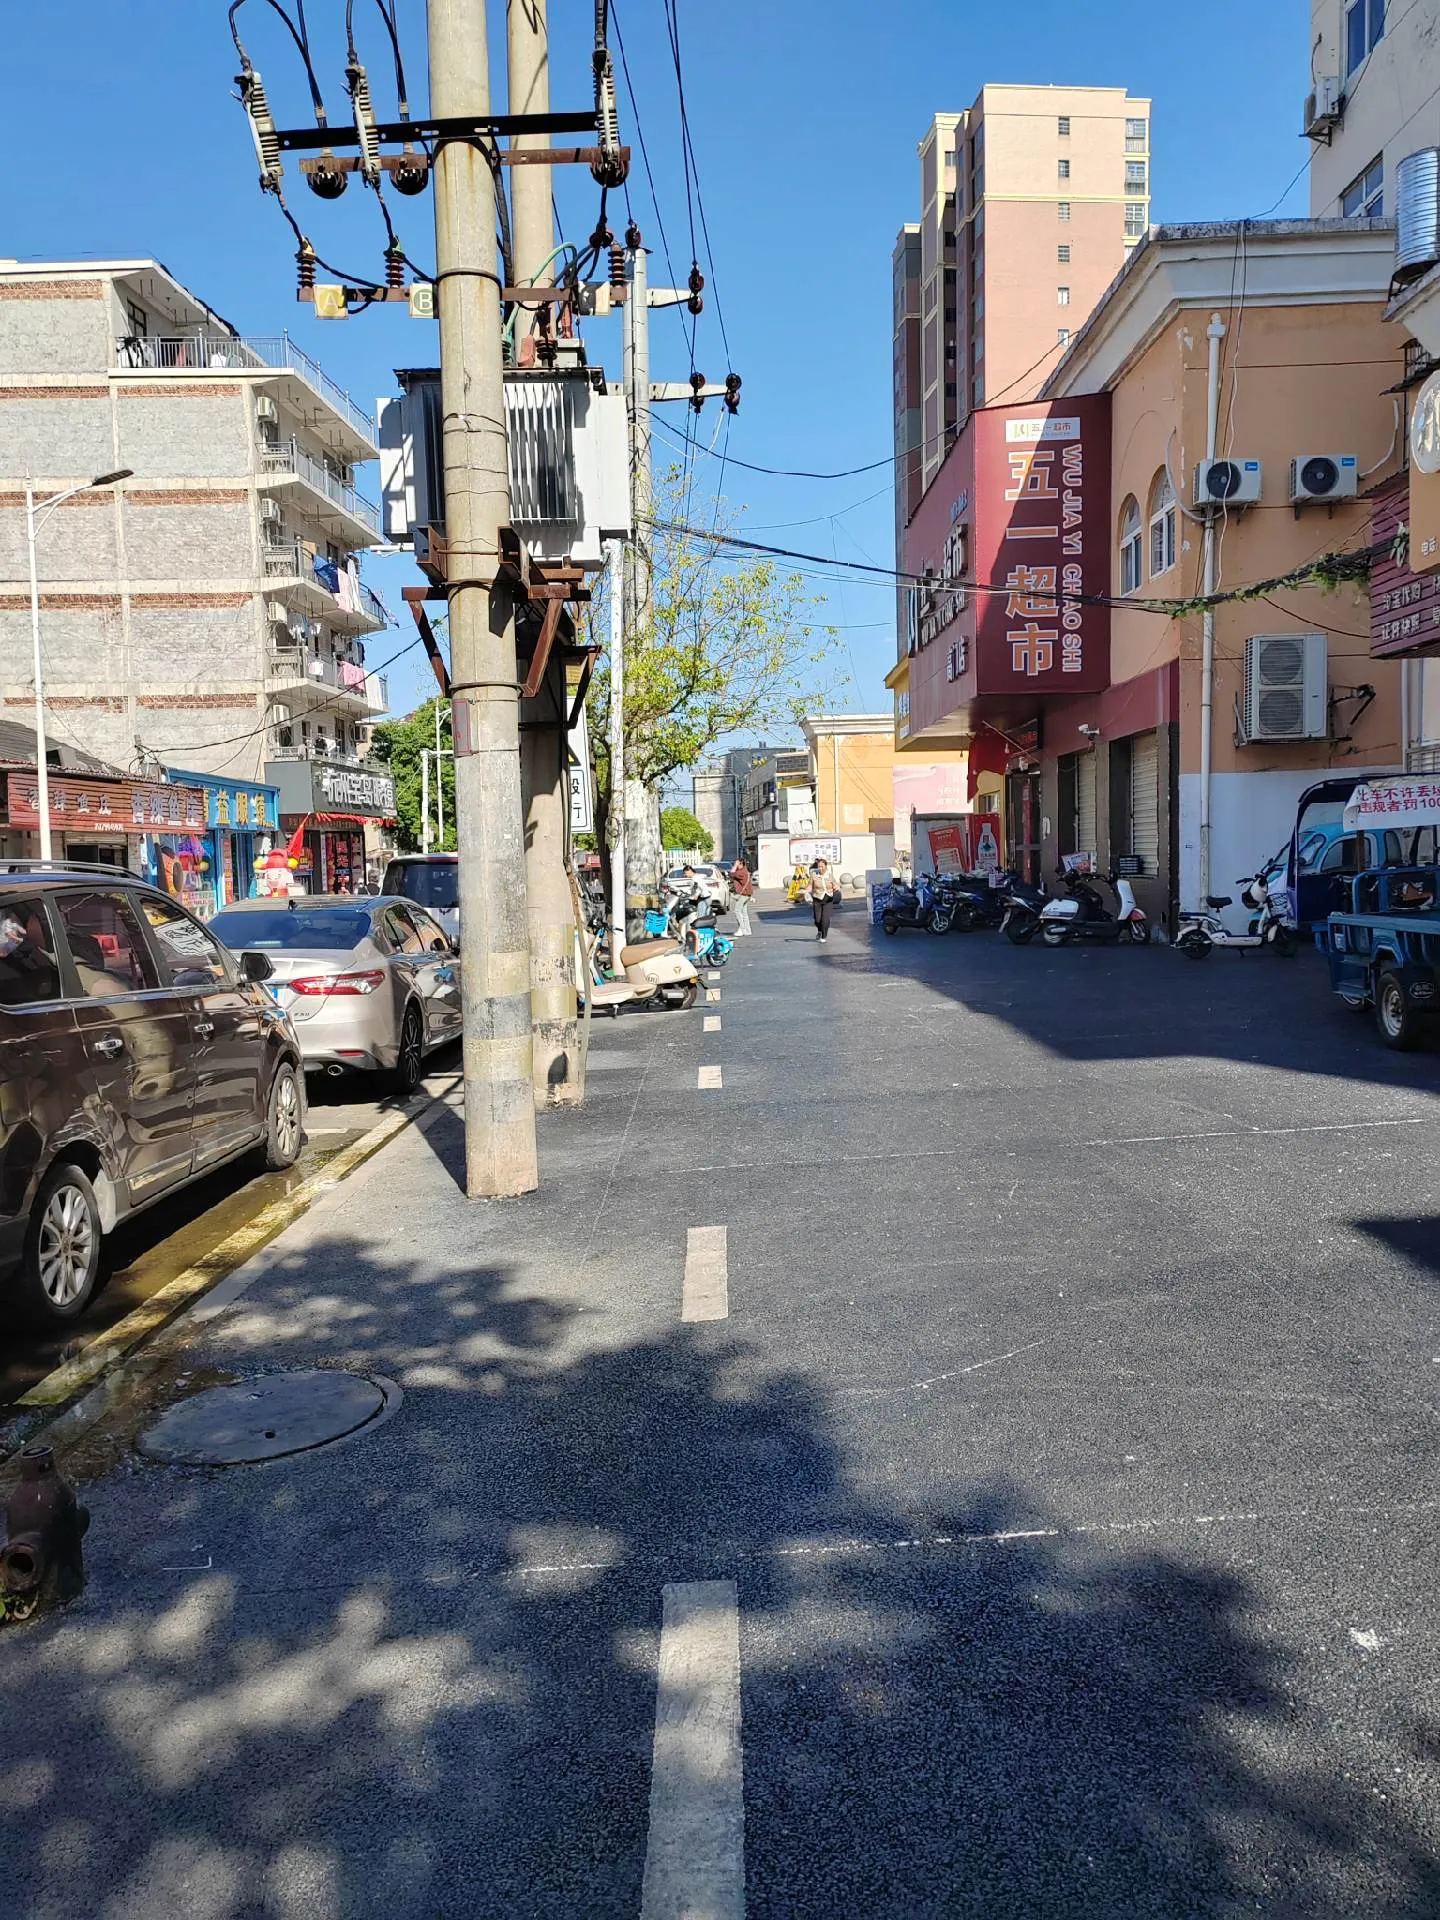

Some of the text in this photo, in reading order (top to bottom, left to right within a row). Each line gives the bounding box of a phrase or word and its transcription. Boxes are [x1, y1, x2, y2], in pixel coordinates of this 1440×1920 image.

[419, 291, 433, 310] B
[1004, 449, 1059, 677] 五一超市
[1062, 443, 1083, 673] WU JIA YI CHAO SHI
[203, 788, 266, 827] 益眼镜
